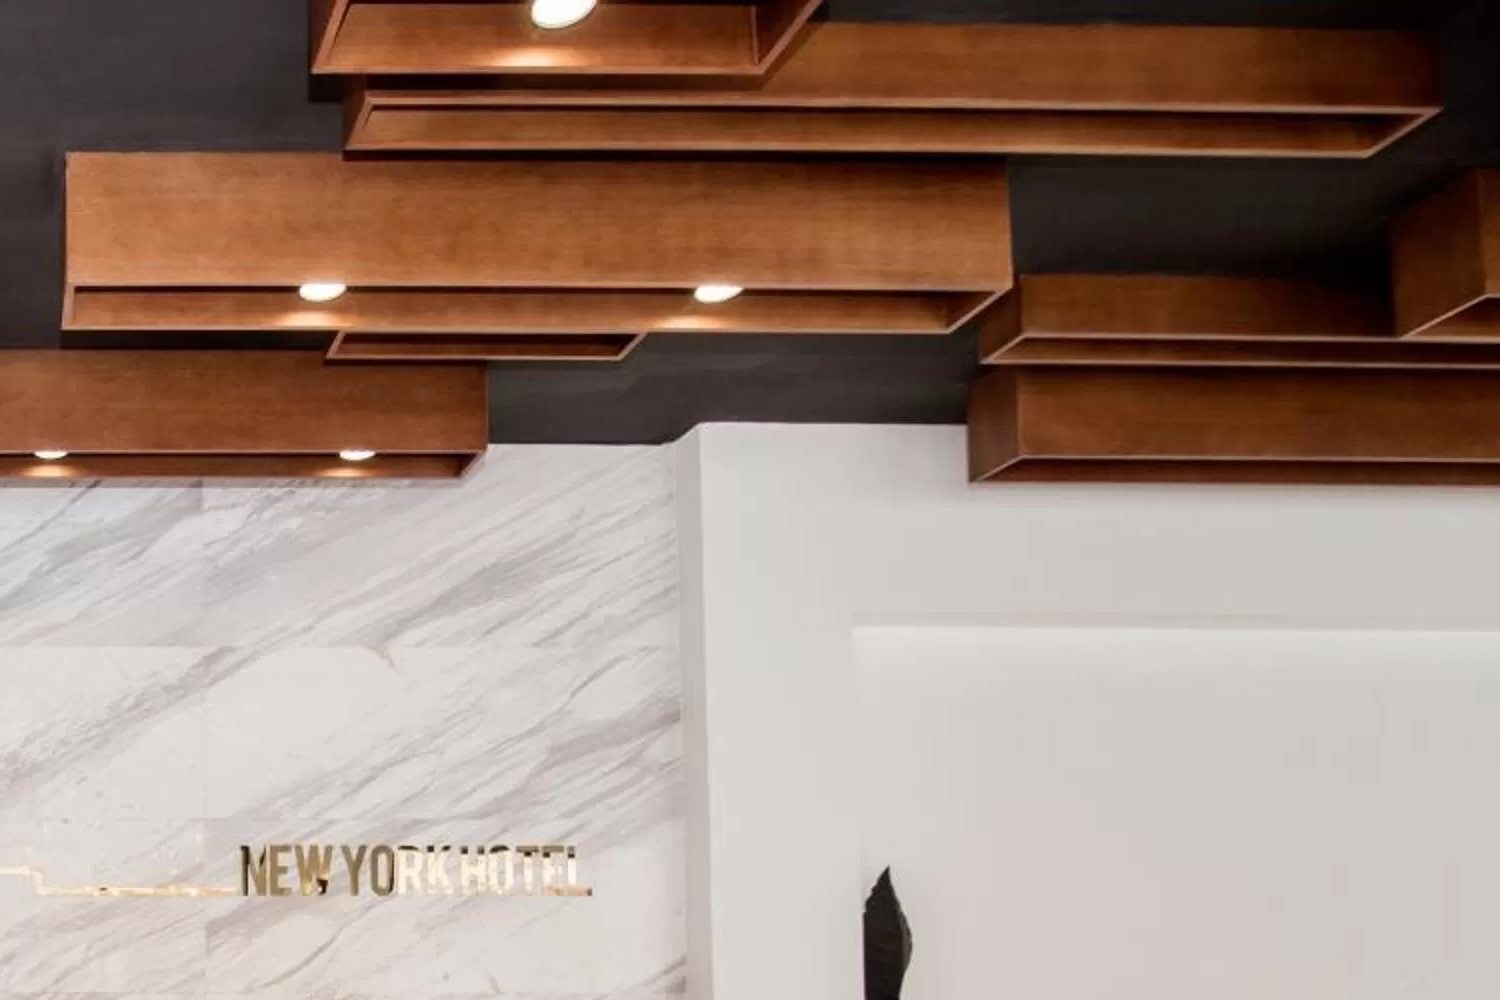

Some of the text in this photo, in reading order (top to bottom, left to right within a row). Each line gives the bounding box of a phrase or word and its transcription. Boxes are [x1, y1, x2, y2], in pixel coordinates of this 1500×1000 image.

[240, 845, 593, 896] NEW YORK HOTEL
